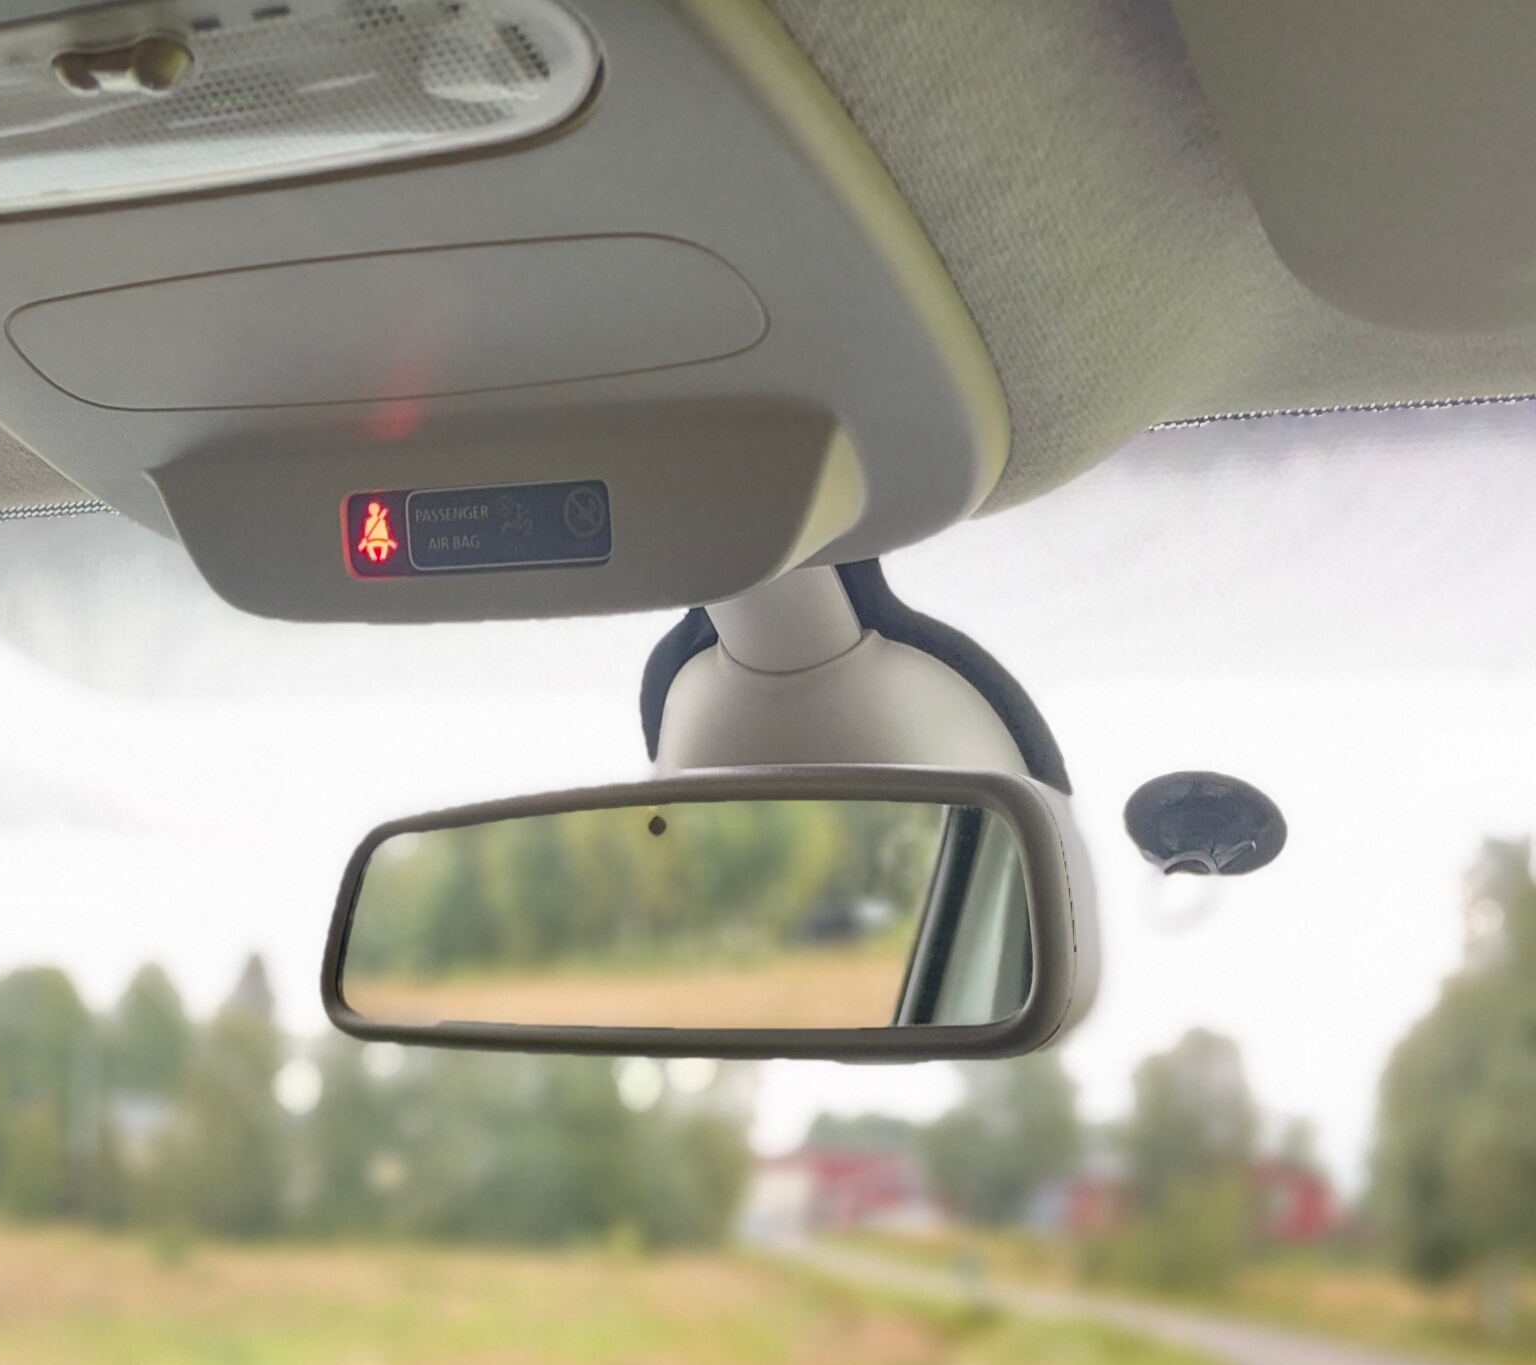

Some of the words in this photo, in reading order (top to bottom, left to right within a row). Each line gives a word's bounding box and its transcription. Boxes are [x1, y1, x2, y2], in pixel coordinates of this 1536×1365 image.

[415, 505, 489, 523] PASSENGER
[428, 537, 450, 551] AIR
[453, 535, 480, 550] BAG
